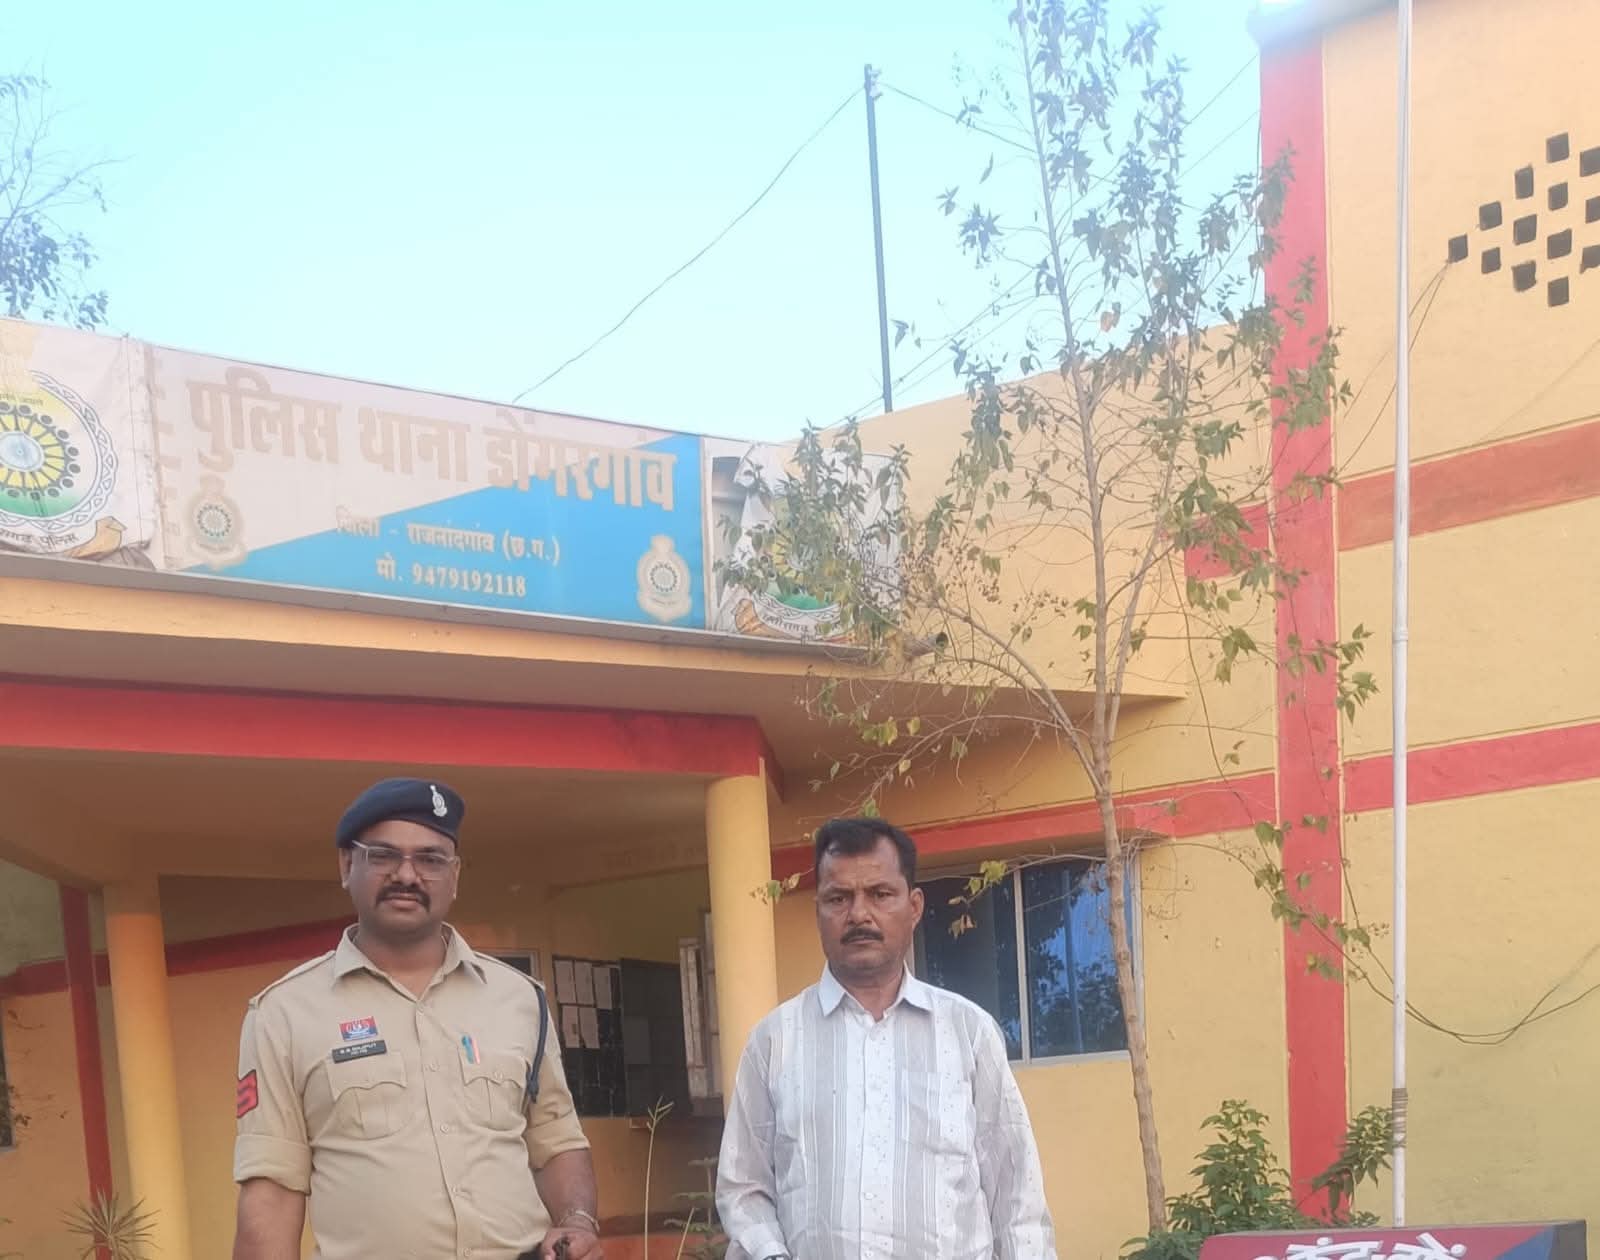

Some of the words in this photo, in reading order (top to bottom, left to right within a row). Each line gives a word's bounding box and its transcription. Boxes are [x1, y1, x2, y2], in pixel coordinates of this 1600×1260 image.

[185, 366, 342, 472] पुलिस
[357, 405, 471, 483] थाना
[412, 562, 527, 598] 9479192118
